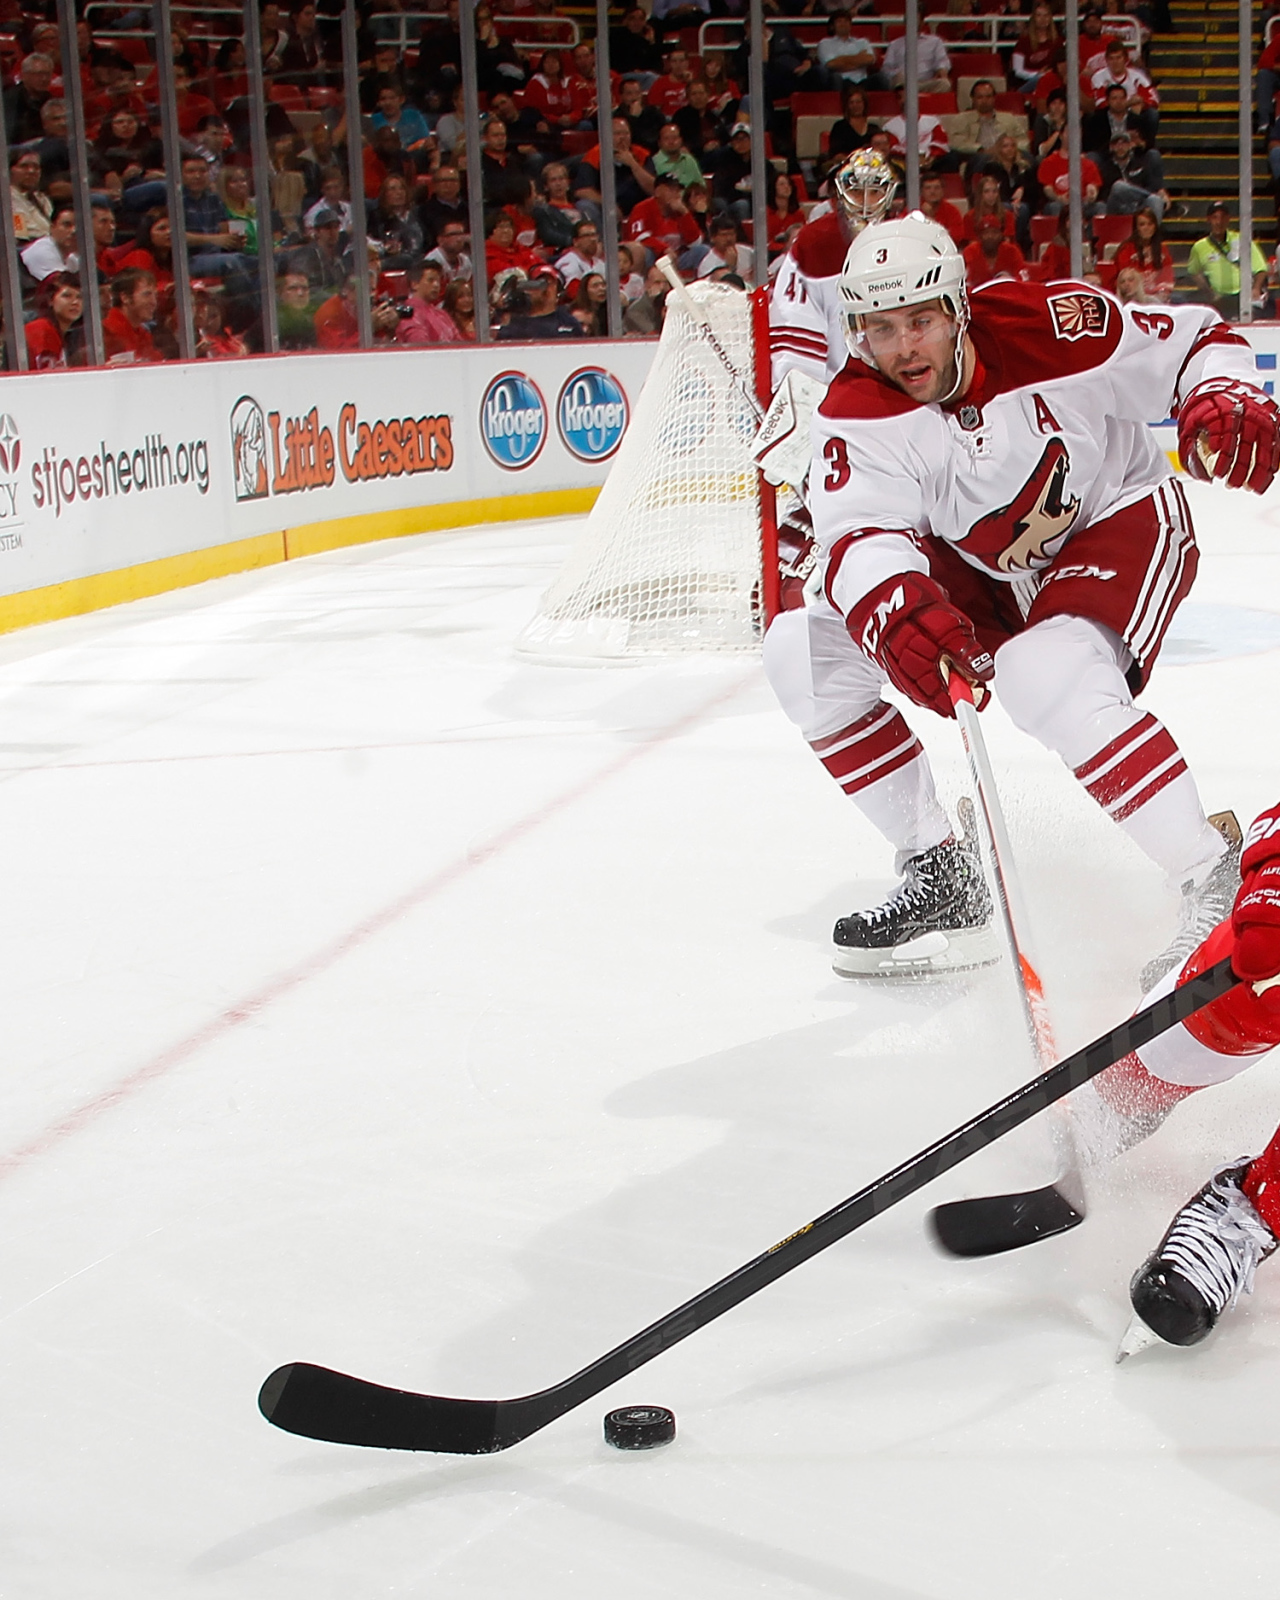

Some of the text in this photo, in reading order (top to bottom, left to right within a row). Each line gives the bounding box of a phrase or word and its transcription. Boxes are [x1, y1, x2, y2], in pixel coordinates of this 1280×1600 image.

[875, 249, 888, 264] 3
[867, 278, 904, 294] Reebok
[1081, 296, 1102, 328] PHX
[1131, 310, 1174, 341] 3
[700, 322, 741, 383] Reebok
[487, 384, 542, 459] Kroger
[564, 380, 623, 452] Kroger
[758, 396, 788, 444] Reebok
[1031, 392, 1063, 435] A
[267, 402, 454, 495] Little Caesars
[823, 436, 851, 493] 3
[31, 433, 211, 519] stjoeshealth.org
